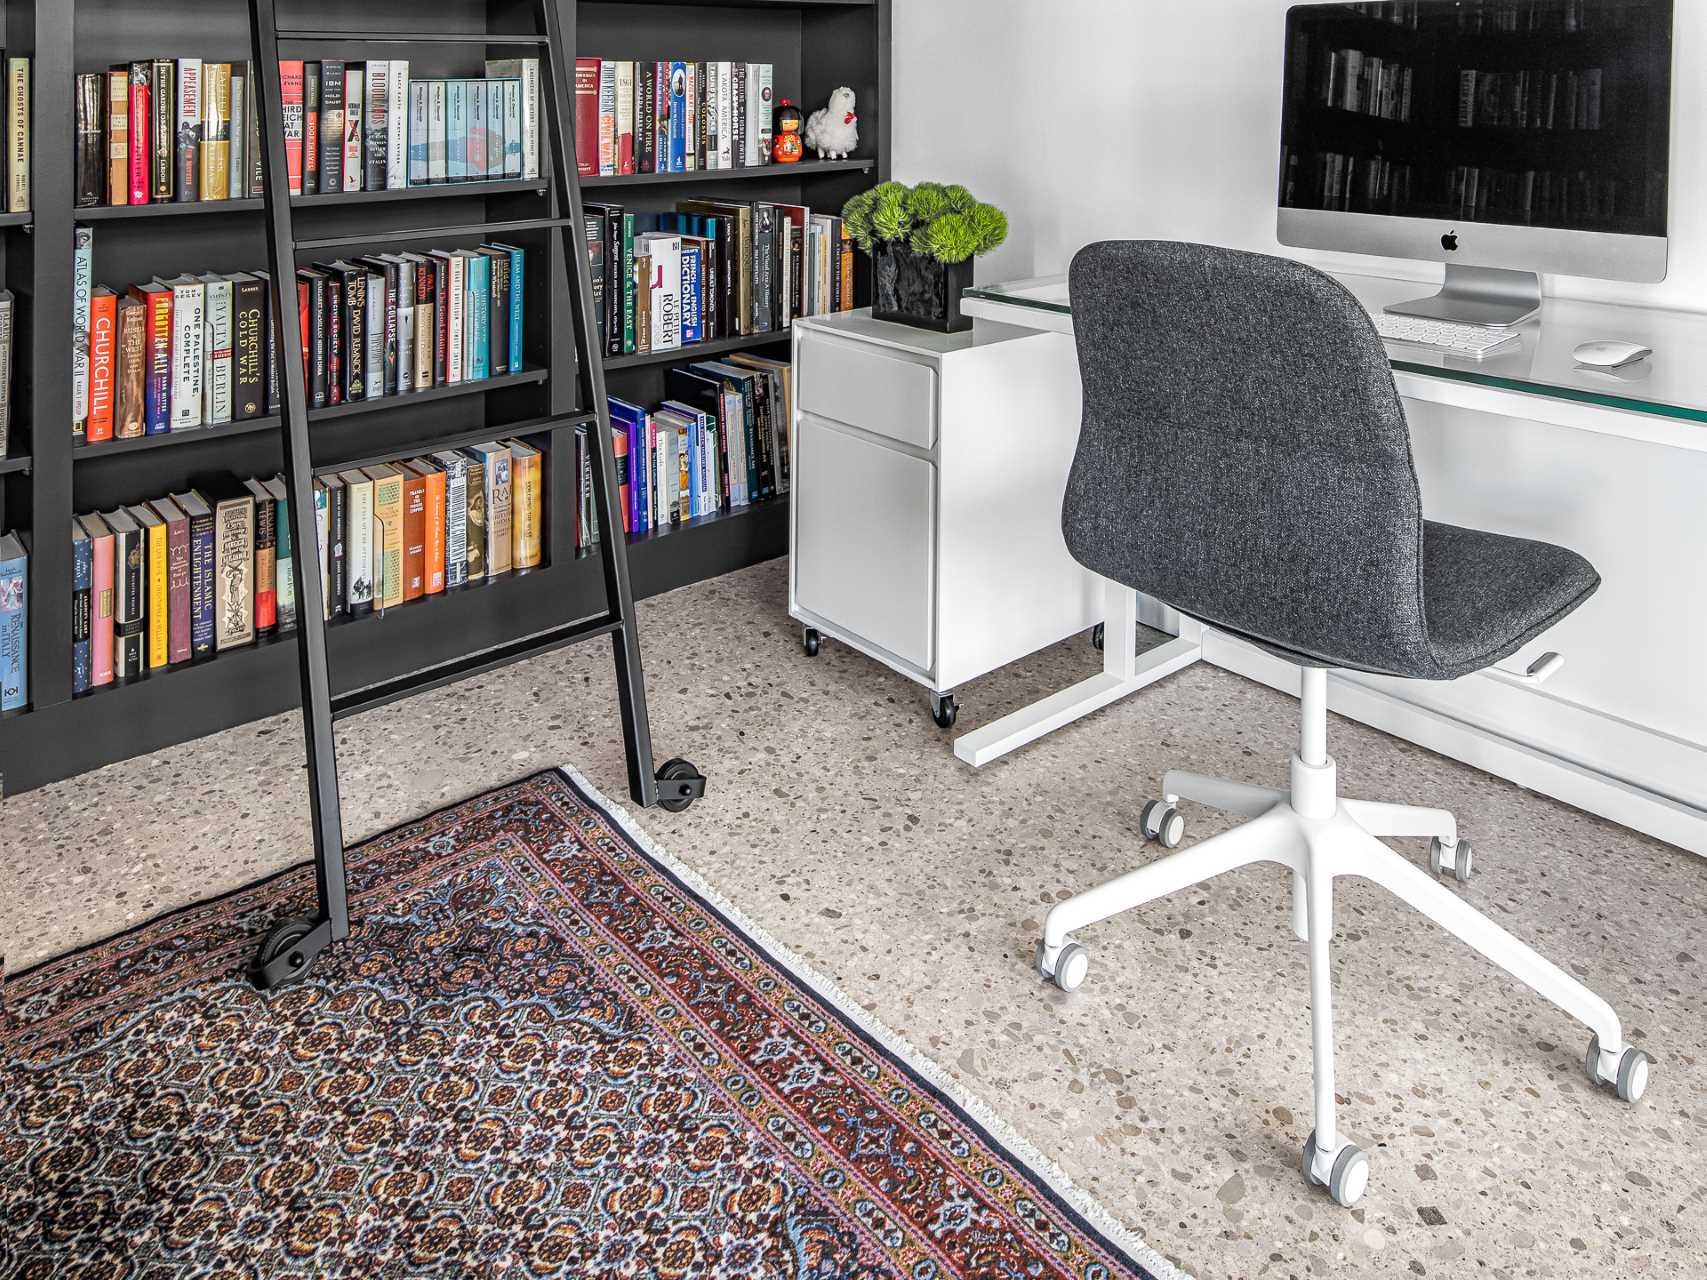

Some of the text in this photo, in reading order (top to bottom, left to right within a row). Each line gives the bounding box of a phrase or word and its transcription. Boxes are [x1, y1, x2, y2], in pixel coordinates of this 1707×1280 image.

[183, 67, 196, 118] APPEASEMENT
[371, 72, 387, 125] BLOODLANDS
[601, 65, 615, 113] JOHN KEEGAN
[721, 72, 729, 140] LAKOTA AMERICA
[17, 119, 24, 128] OF
[646, 115, 652, 129] ON
[75, 256, 88, 284] ATLAS
[356, 277, 365, 308] LENIN'S
[681, 256, 691, 326] DICTIONARY
[690, 255, 698, 280] FRENCH
[75, 287, 88, 302] OF
[347, 280, 357, 306] TOMB
[388, 288, 397, 342] THE COLLAPSE
[513, 304, 521, 320] WEST
[689, 296, 697, 326] ENGLISH
[74, 304, 87, 344] WORLD
[153, 297, 170, 375] FORGOTTEN ALLY
[215, 304, 227, 347] YALTA
[352, 310, 361, 376] DAVID REMNICK
[662, 293, 674, 345] ROBERT
[673, 311, 681, 336] PETIT
[74, 346, 86, 372] WAR
[93, 316, 111, 415] CHURCHILL
[182, 324, 191, 383] COMPLETE
[191, 307, 201, 398] ONE PALESTINE,
[240, 311, 248, 384] COLD WAR
[248, 309, 260, 383] CHURCHILL'S
[215, 364, 226, 414] BERLIN
[451, 528, 466, 561] COMPANY
[193, 539, 202, 619] ENLIGHTENMENT
[204, 542, 213, 610] THE ISLAMIC
[1, 635, 10, 658] ITALY
[10, 613, 21, 672] RENAISSANCE
